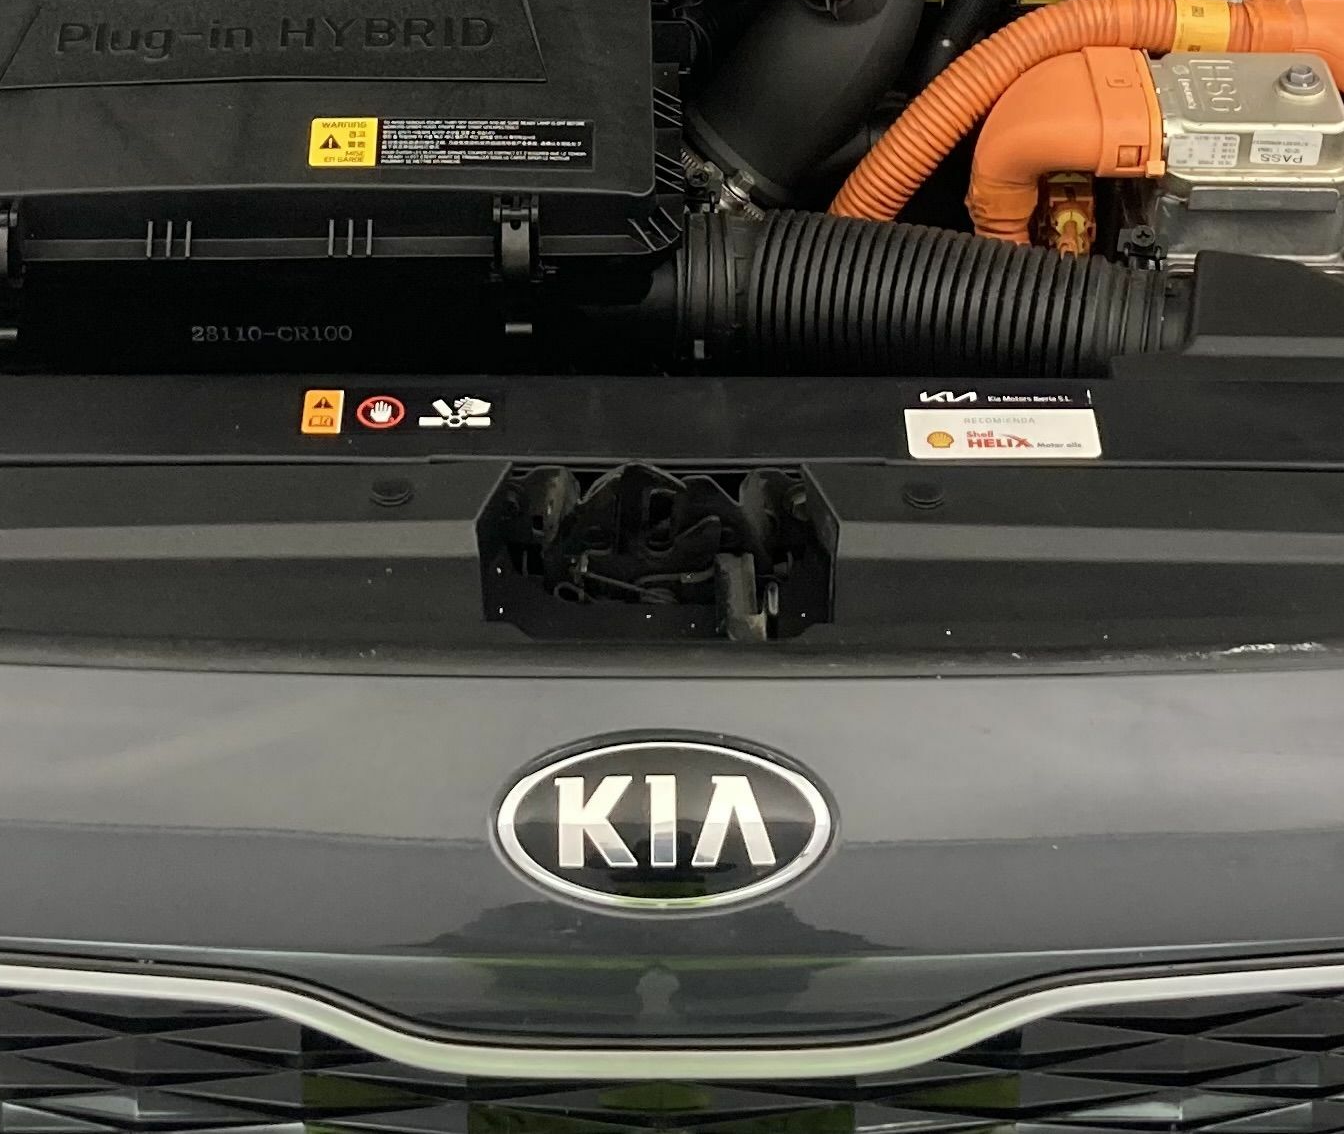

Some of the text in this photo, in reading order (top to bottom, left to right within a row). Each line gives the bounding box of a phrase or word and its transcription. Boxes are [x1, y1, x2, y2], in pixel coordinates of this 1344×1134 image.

[56, 16, 497, 63] Plug-in HYBRID
[1260, 153, 1303, 164] PASS
[191, 324, 353, 342] 28110-CR100
[966, 430, 994, 438] Shell
[967, 435, 1034, 449] HELIX
[554, 773, 777, 868] KIA
